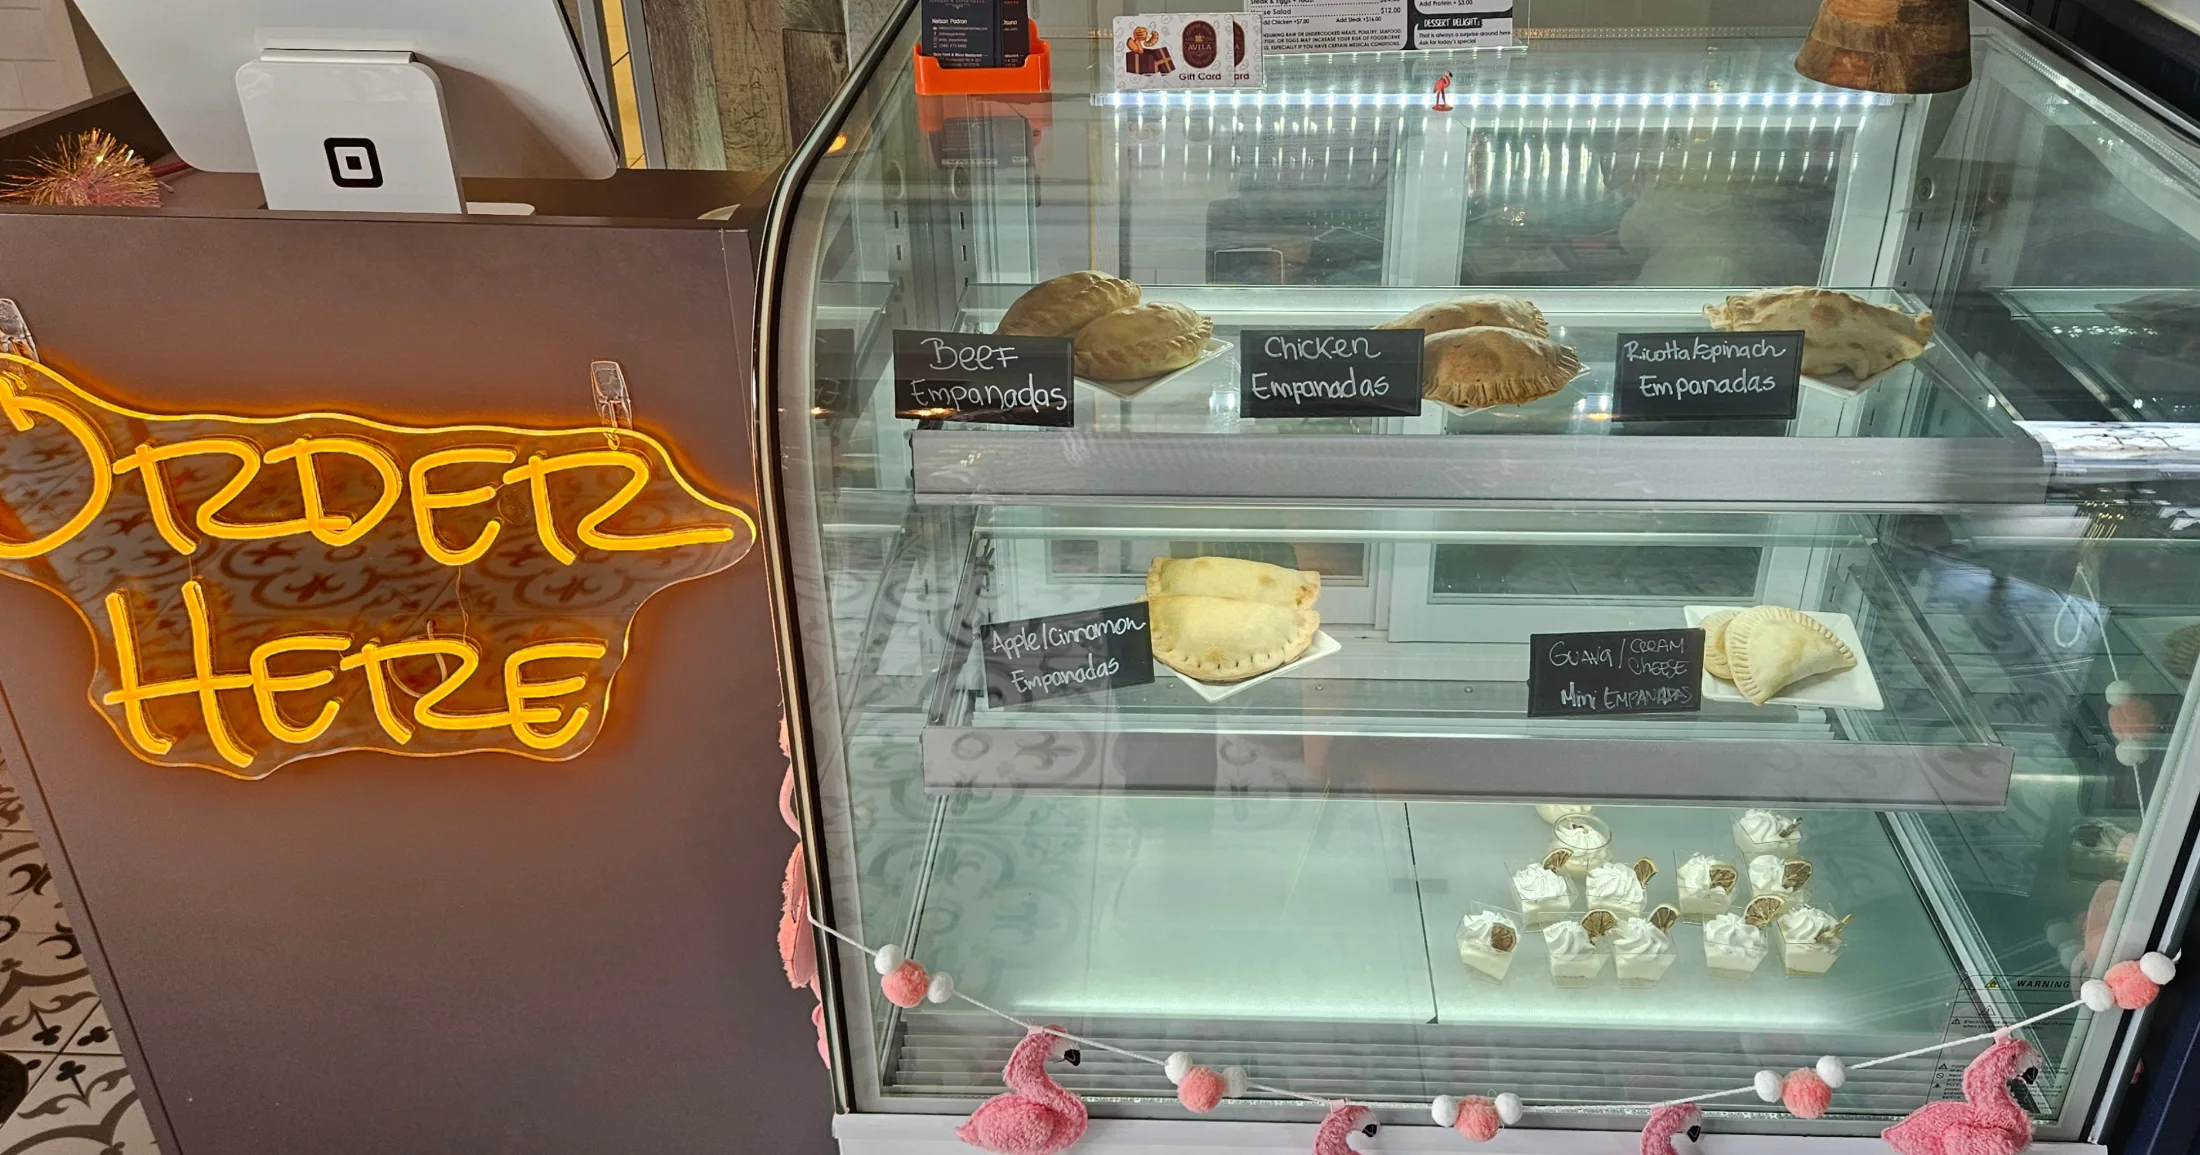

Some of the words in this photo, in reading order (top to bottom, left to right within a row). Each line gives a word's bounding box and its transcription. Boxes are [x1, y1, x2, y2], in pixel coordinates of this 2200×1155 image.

[1424, 18, 1451, 27] DESSERT
[1452, 17, 1481, 27] DELIGHT:
[1188, 43, 1212, 51] AVILA
[1178, 73, 1196, 81] Gift
[1197, 73, 1222, 81] Card
[1234, 72, 1250, 81] ard
[910, 372, 1068, 413] Empanadas
[1251, 366, 1390, 405] Empanadas
[1638, 368, 1777, 401] Empanadas
[0, 374, 734, 566] ORDER
[991, 616, 1147, 660] Apple/Cinnamon
[103, 580, 607, 767] HERE
[1011, 652, 1121, 694] Empanadas
[1560, 681, 1598, 710] Mini
[2016, 979, 2071, 989] WARNING
